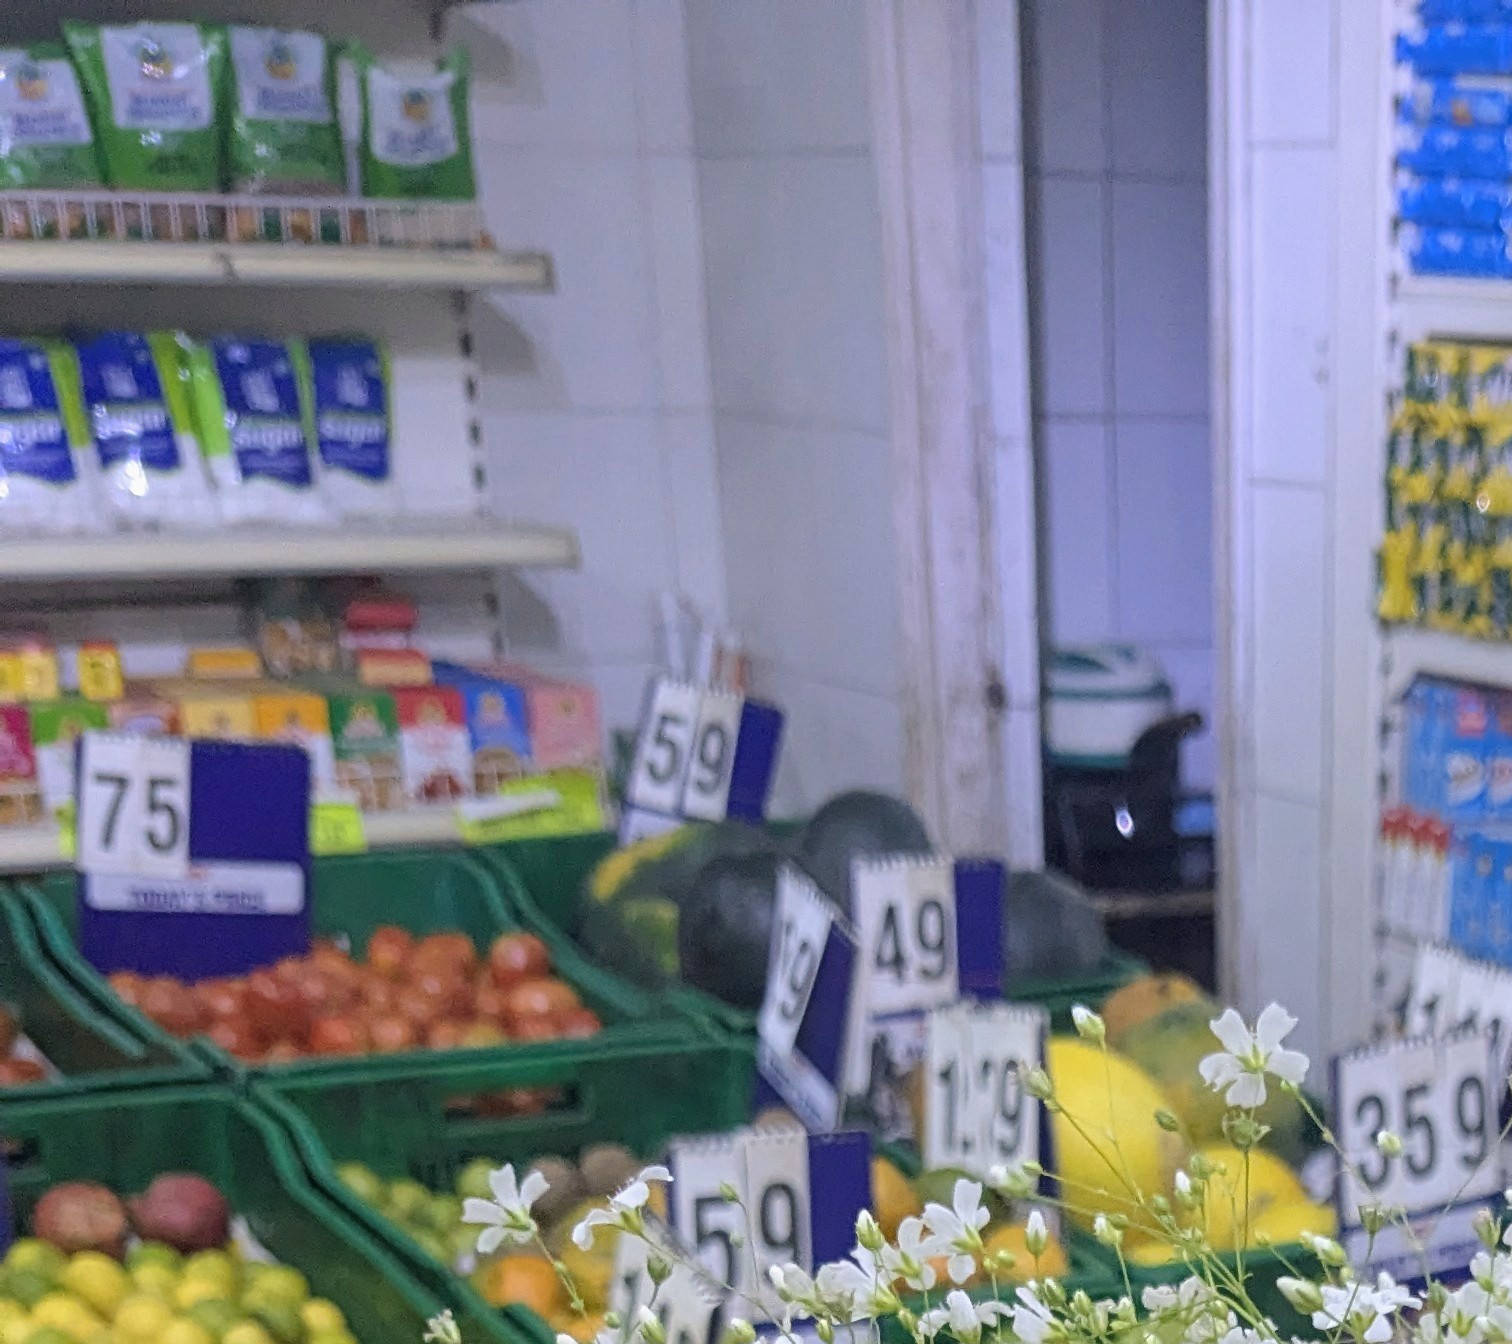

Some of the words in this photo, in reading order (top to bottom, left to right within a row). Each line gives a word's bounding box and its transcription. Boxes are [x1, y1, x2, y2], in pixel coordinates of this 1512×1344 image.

[646, 712, 727, 795] 59
[94, 771, 181, 853] 75
[873, 899, 947, 980] 49
[1356, 1074, 1488, 1189] 359
[695, 1182, 800, 1300] 59
